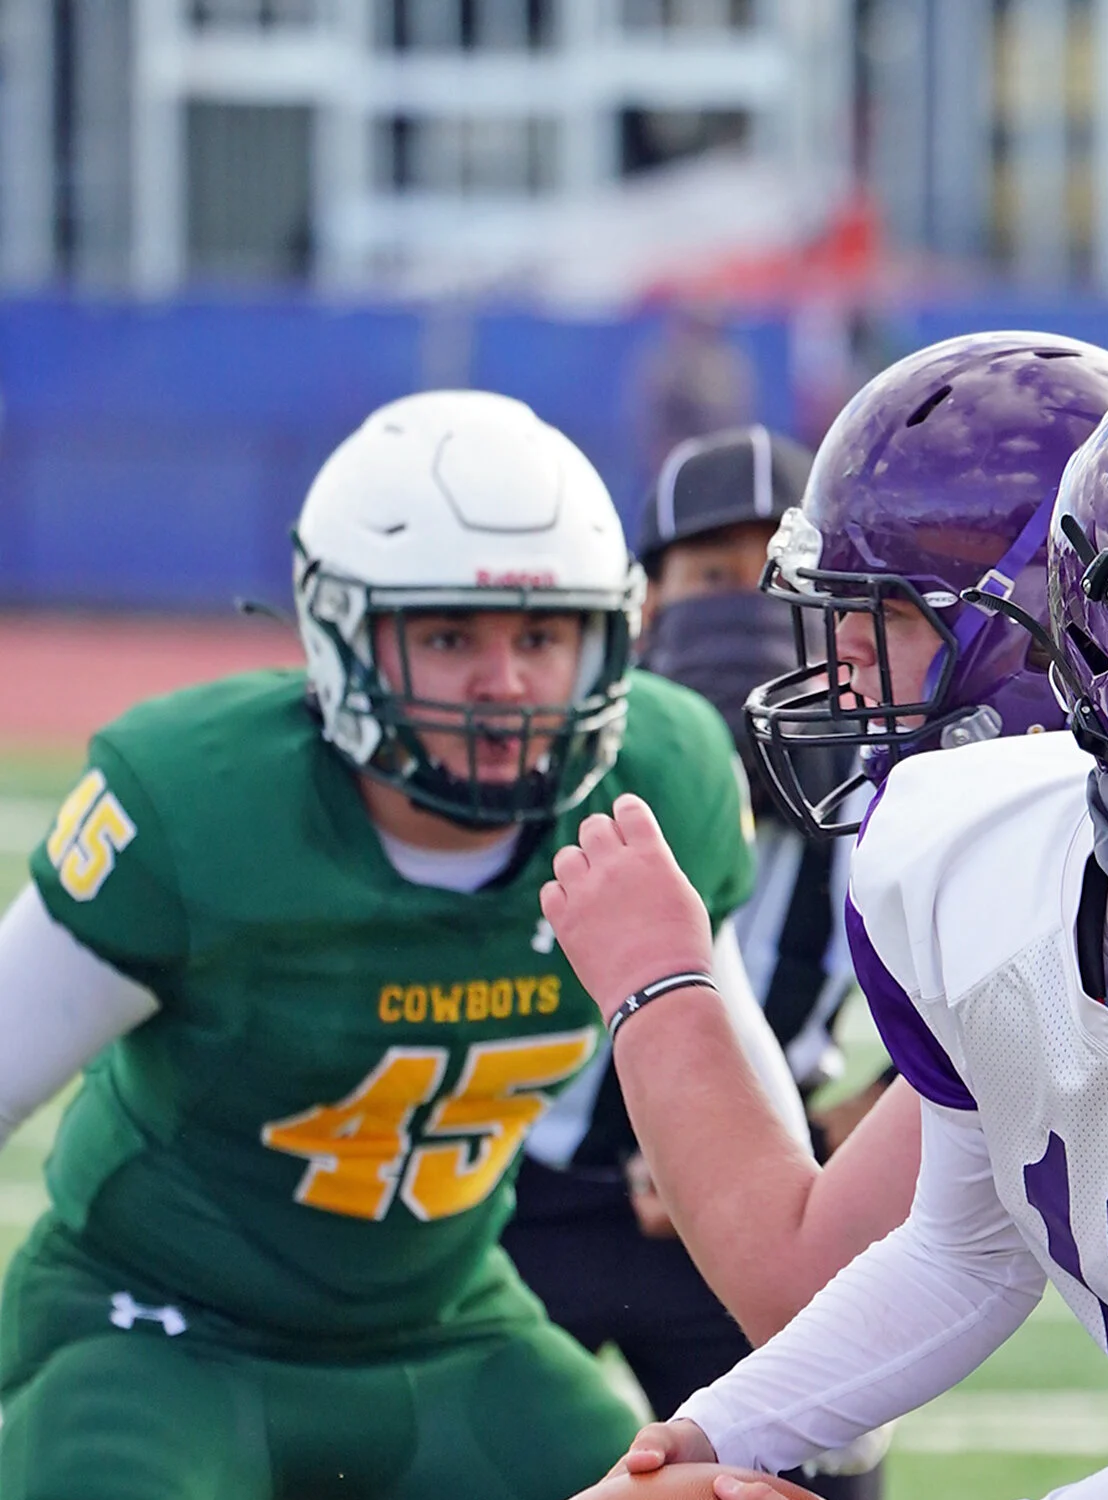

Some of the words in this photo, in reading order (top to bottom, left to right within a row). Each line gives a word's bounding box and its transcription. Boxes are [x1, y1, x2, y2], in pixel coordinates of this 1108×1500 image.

[47, 767, 137, 902] 45
[378, 976, 561, 1023] COWBOYS
[260, 1025, 598, 1222] 45
